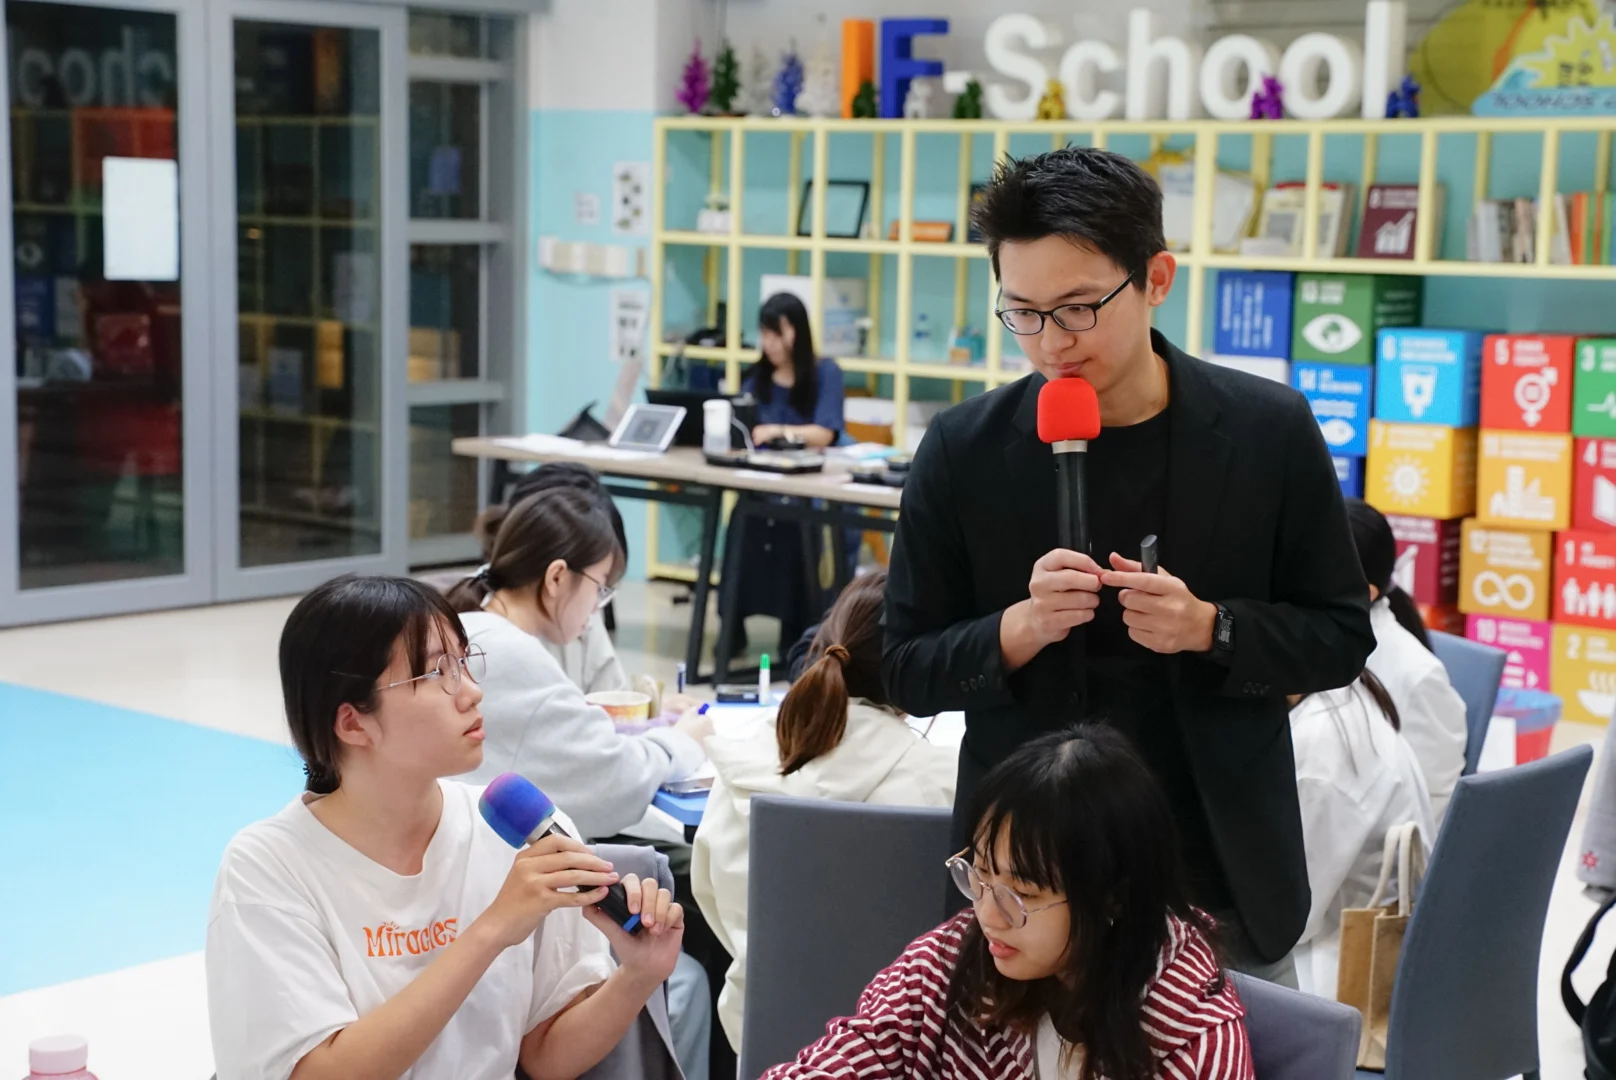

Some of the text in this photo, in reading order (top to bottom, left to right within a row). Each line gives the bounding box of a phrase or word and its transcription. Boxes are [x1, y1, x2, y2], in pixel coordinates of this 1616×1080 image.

[1495, 338, 1509, 366] 5
[1581, 344, 1595, 372] 3
[1583, 440, 1598, 466] 4
[1564, 540, 1576, 565] 1
[1566, 633, 1581, 660] 2
[363, 918, 457, 957] Miracles
